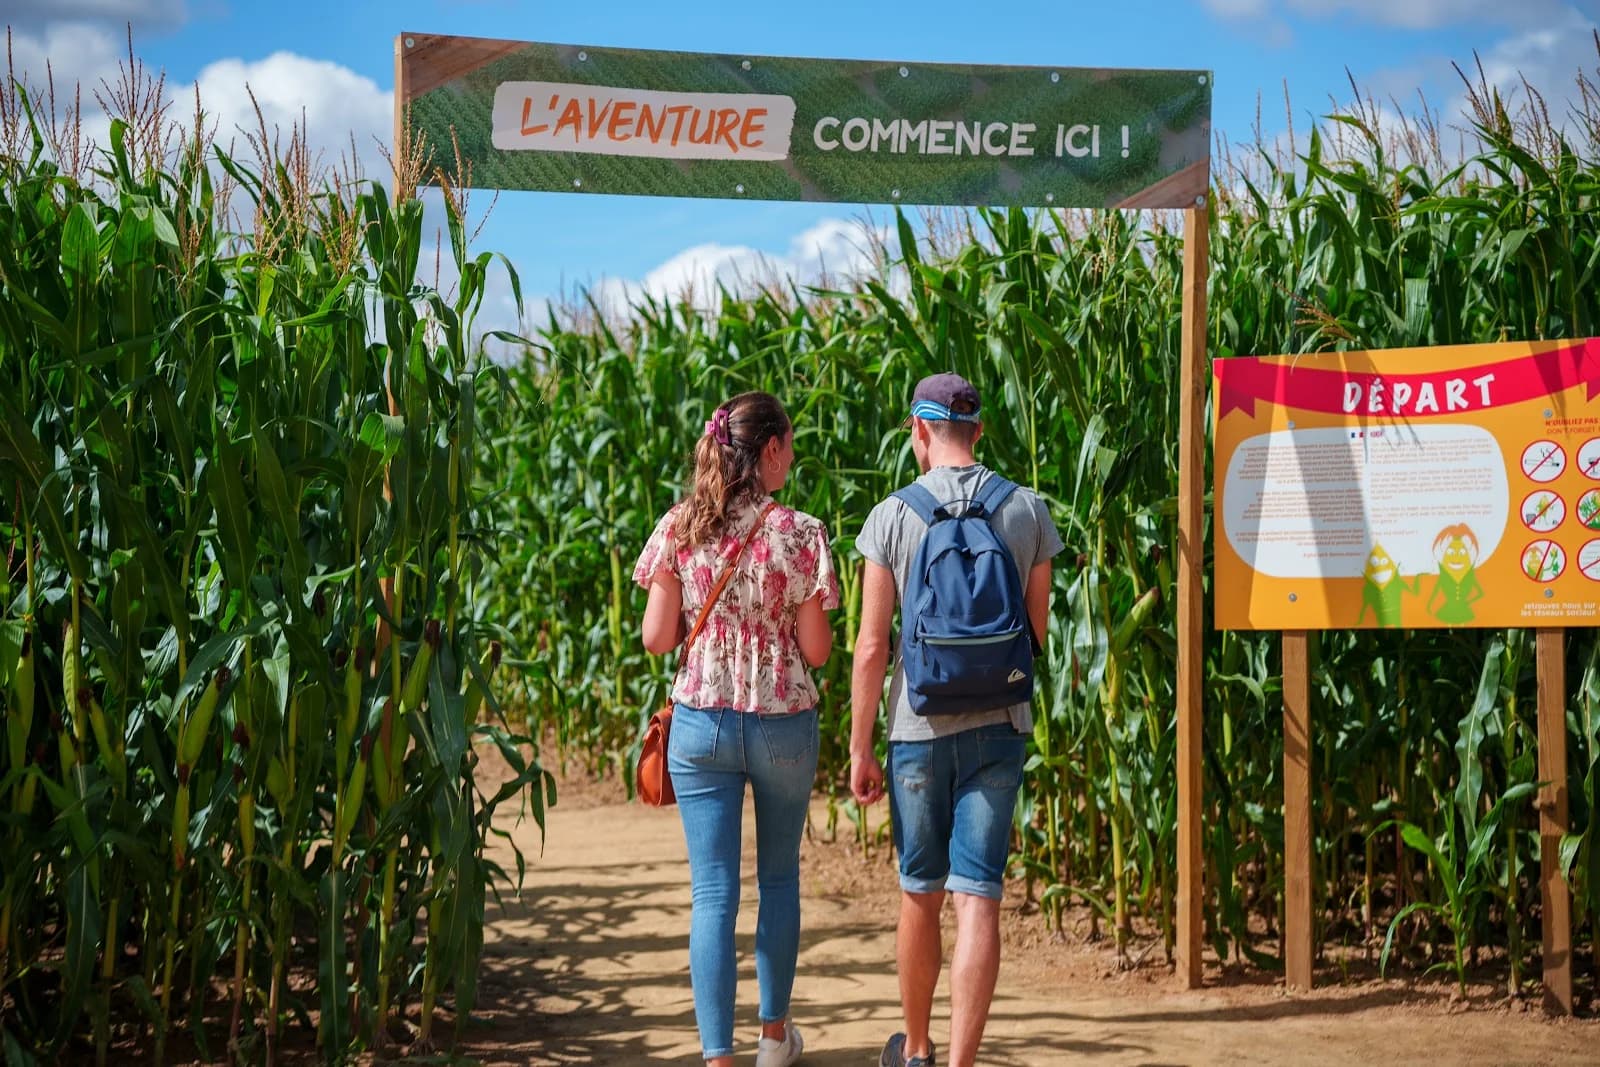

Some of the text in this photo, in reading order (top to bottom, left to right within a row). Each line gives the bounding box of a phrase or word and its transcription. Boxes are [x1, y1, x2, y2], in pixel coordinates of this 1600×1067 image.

[520, 94, 769, 153] L'AVENTURE
[813, 116, 1130, 158] COMMENCE ICI !
[1342, 374, 1495, 414] DÉPART
